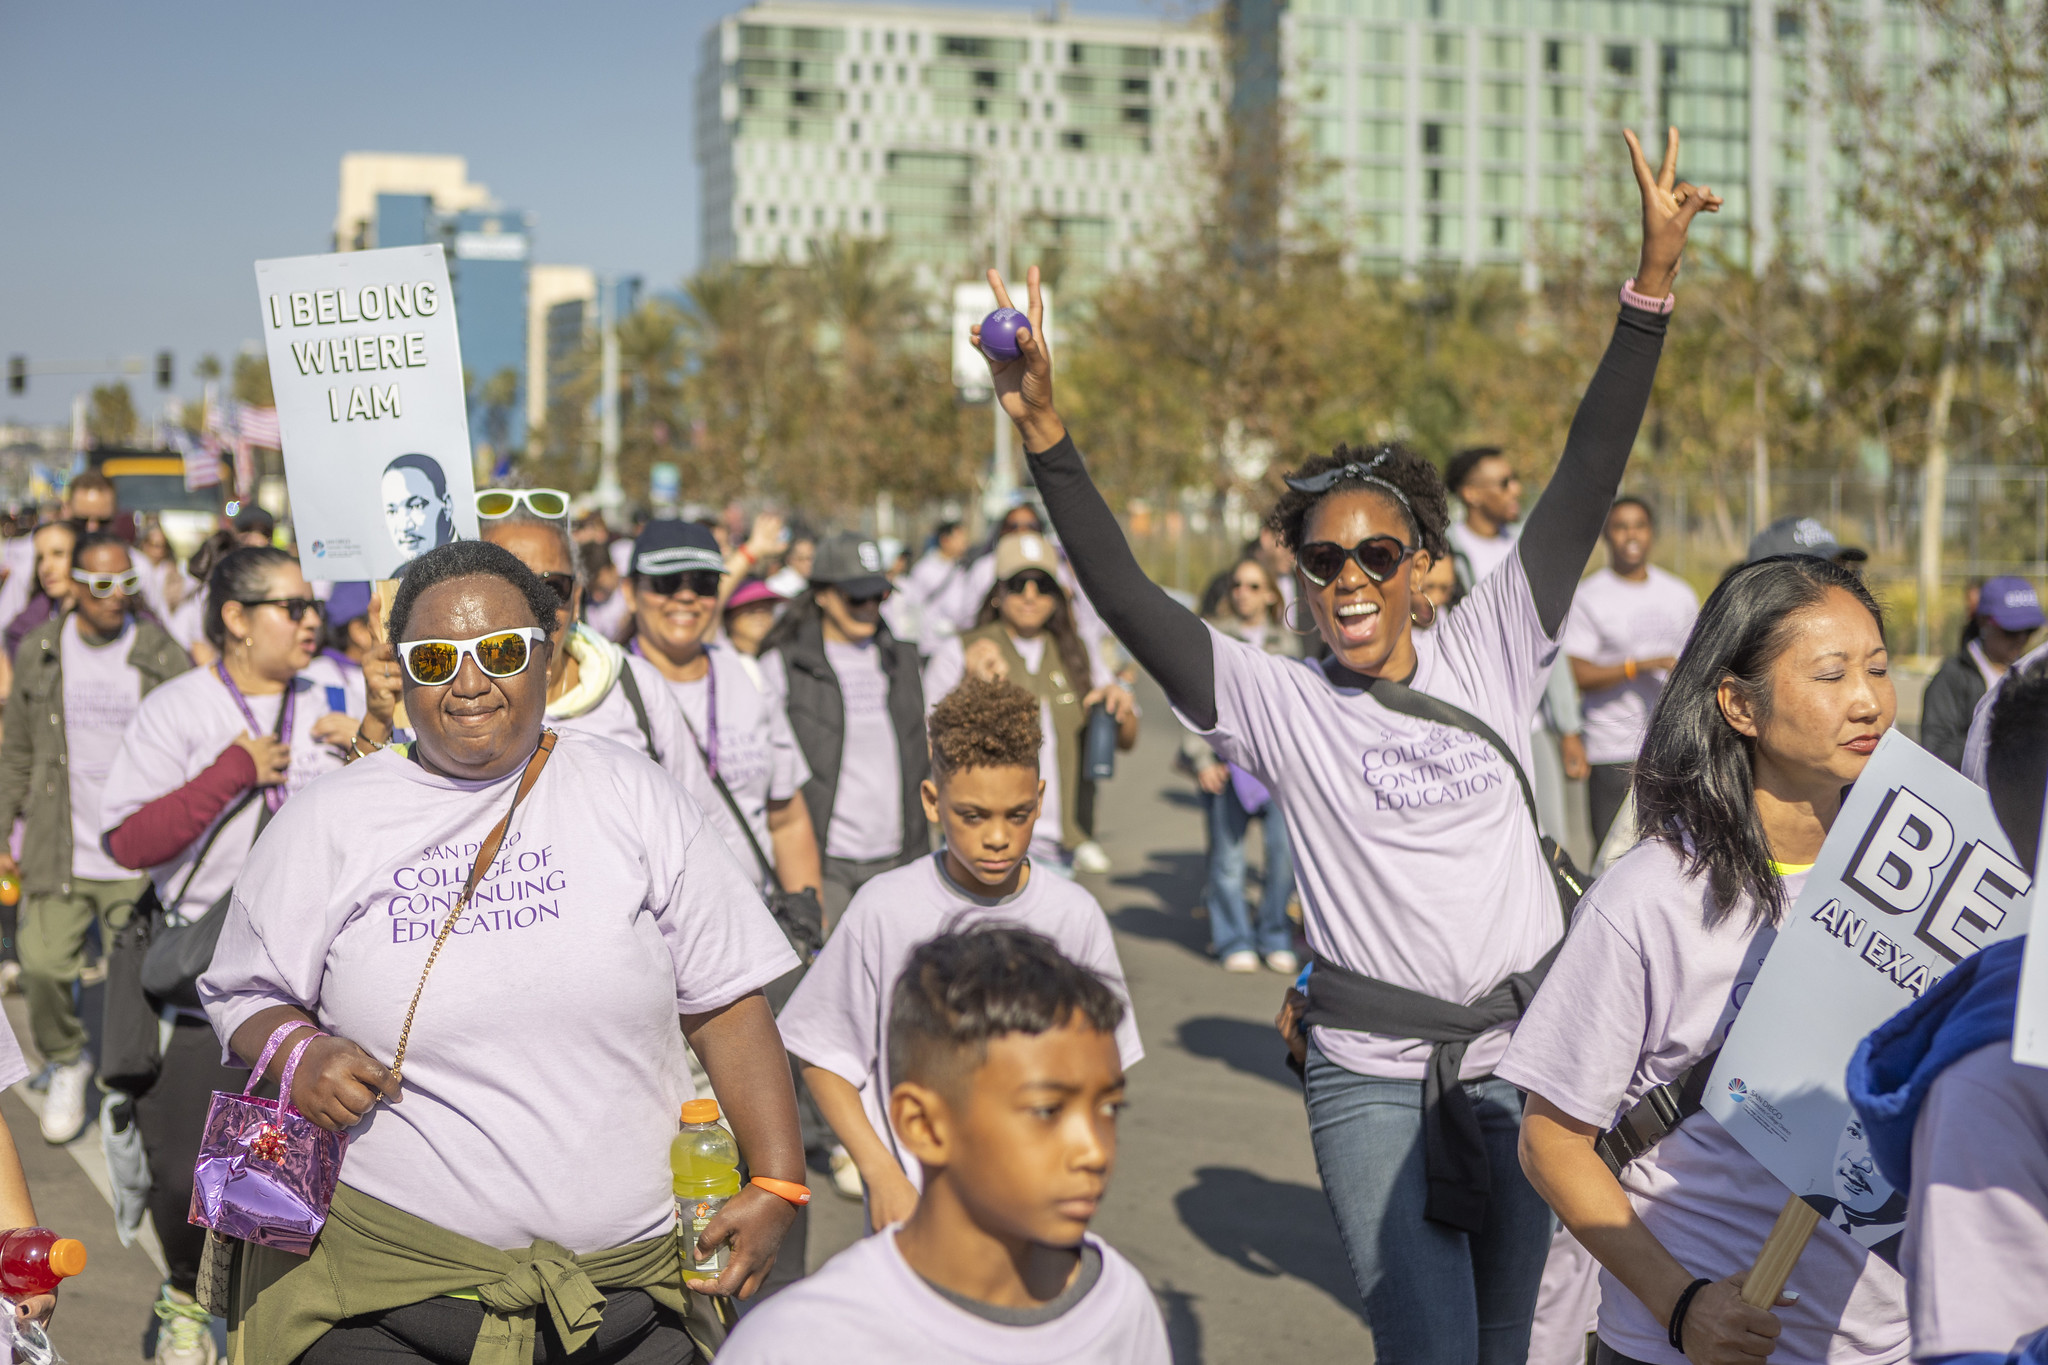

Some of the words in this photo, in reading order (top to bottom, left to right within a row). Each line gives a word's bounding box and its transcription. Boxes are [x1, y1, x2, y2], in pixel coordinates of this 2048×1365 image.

[270, 294, 282, 329] I
[290, 281, 439, 328] BELONG
[291, 332, 428, 376] WHERE
[328, 386, 339, 422] I
[347, 382, 401, 421] AM
[1374, 768, 1502, 811] EDUCATION
[421, 845, 459, 861] SAN
[518, 845, 552, 872] OF
[1840, 785, 2034, 967] BE
[392, 899, 560, 944] EDUCATION
[1810, 898, 1867, 948] AN
[1761, 1100, 1783, 1120] DIEGO
